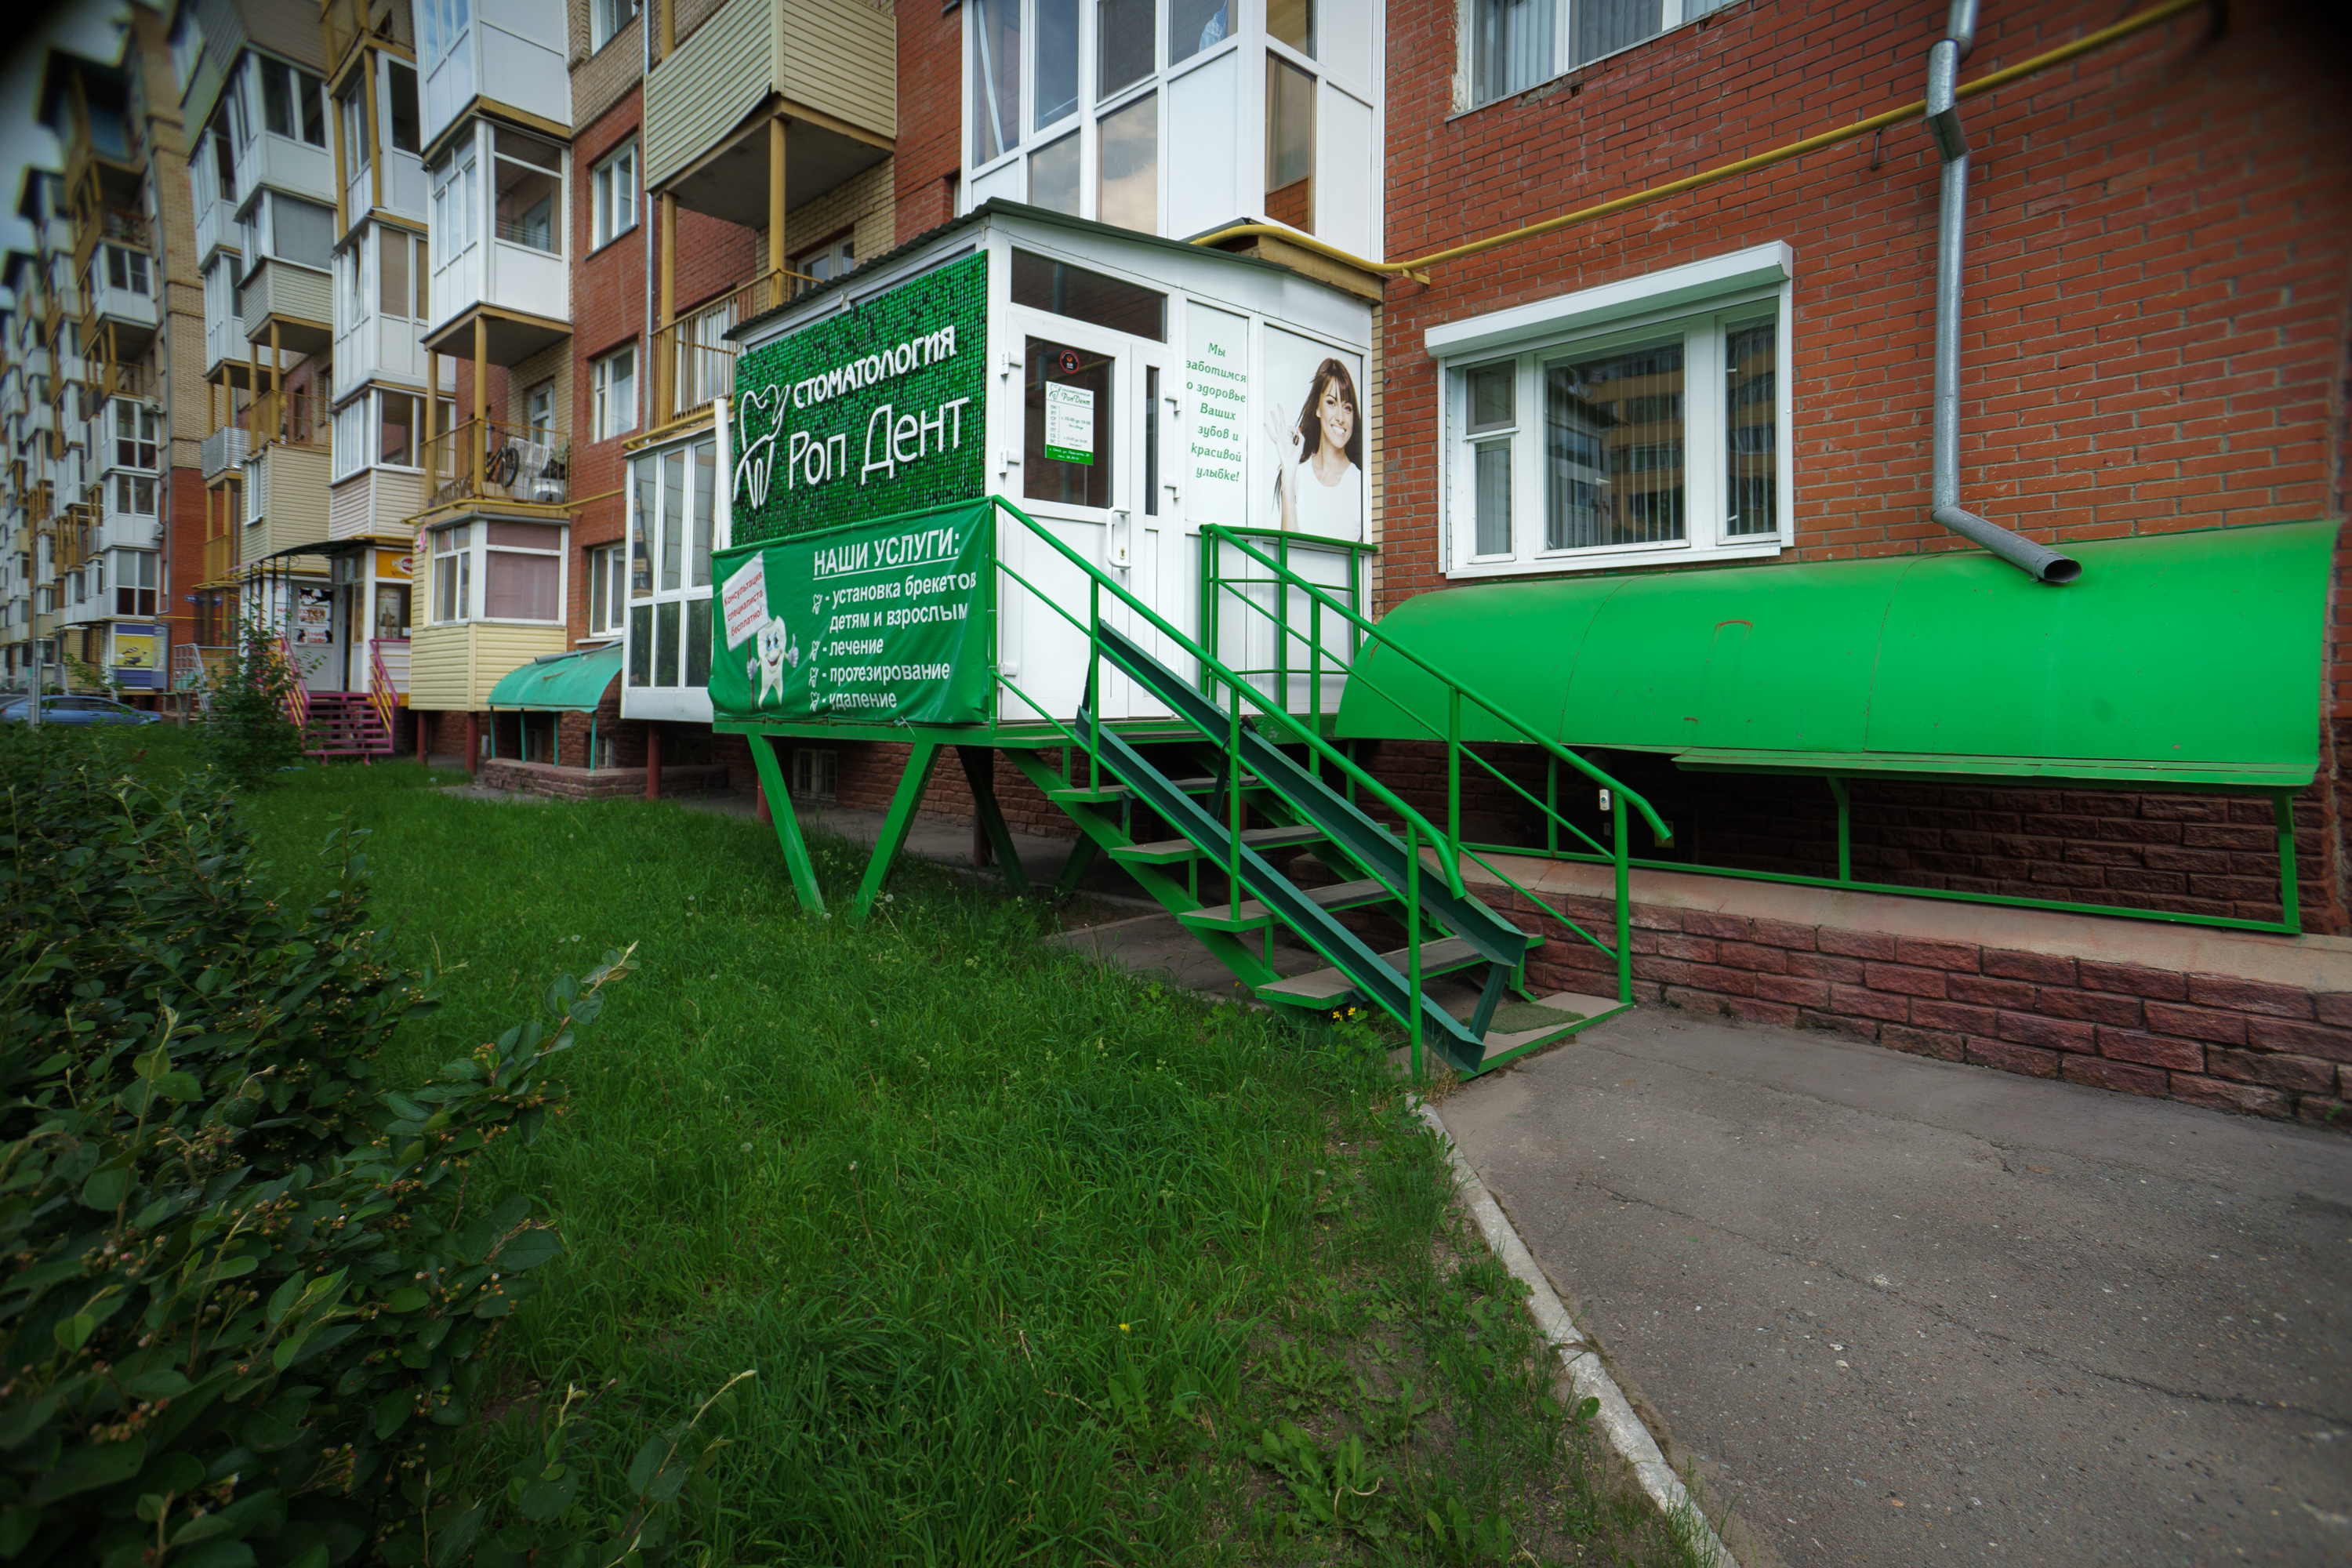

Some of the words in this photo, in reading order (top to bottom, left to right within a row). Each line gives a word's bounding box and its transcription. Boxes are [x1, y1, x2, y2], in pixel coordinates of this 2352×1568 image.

[1208, 343, 1225, 357] Мы
[793, 325, 955, 408] СТОМАТОЛОГИЯ
[1186, 360, 1247, 383] заботимся
[1196, 384, 1246, 402] здоровье
[1200, 402, 1236, 420] Ваших
[789, 431, 846, 490] Роп
[861, 397, 970, 485] Дент
[1197, 426, 1229, 439] зубов
[1232, 433, 1239, 441] и
[1191, 442, 1242, 462] красивой
[1196, 467, 1240, 482] улыбке!
[814, 542, 869, 576] НАШИ
[874, 527, 960, 567] УСЛУГИ:
[724, 572, 763, 607] Консультация
[832, 582, 901, 610] установка
[905, 572, 977, 601] брекетов
[728, 590, 764, 622] специалиста
[829, 612, 869, 633] детям
[874, 612, 882, 626] и
[887, 602, 968, 630] взрослым
[731, 606, 763, 637] бесплатно!
[829, 638, 884, 656] лечение
[830, 662, 950, 686] протезирование
[829, 692, 897, 710] удаление
